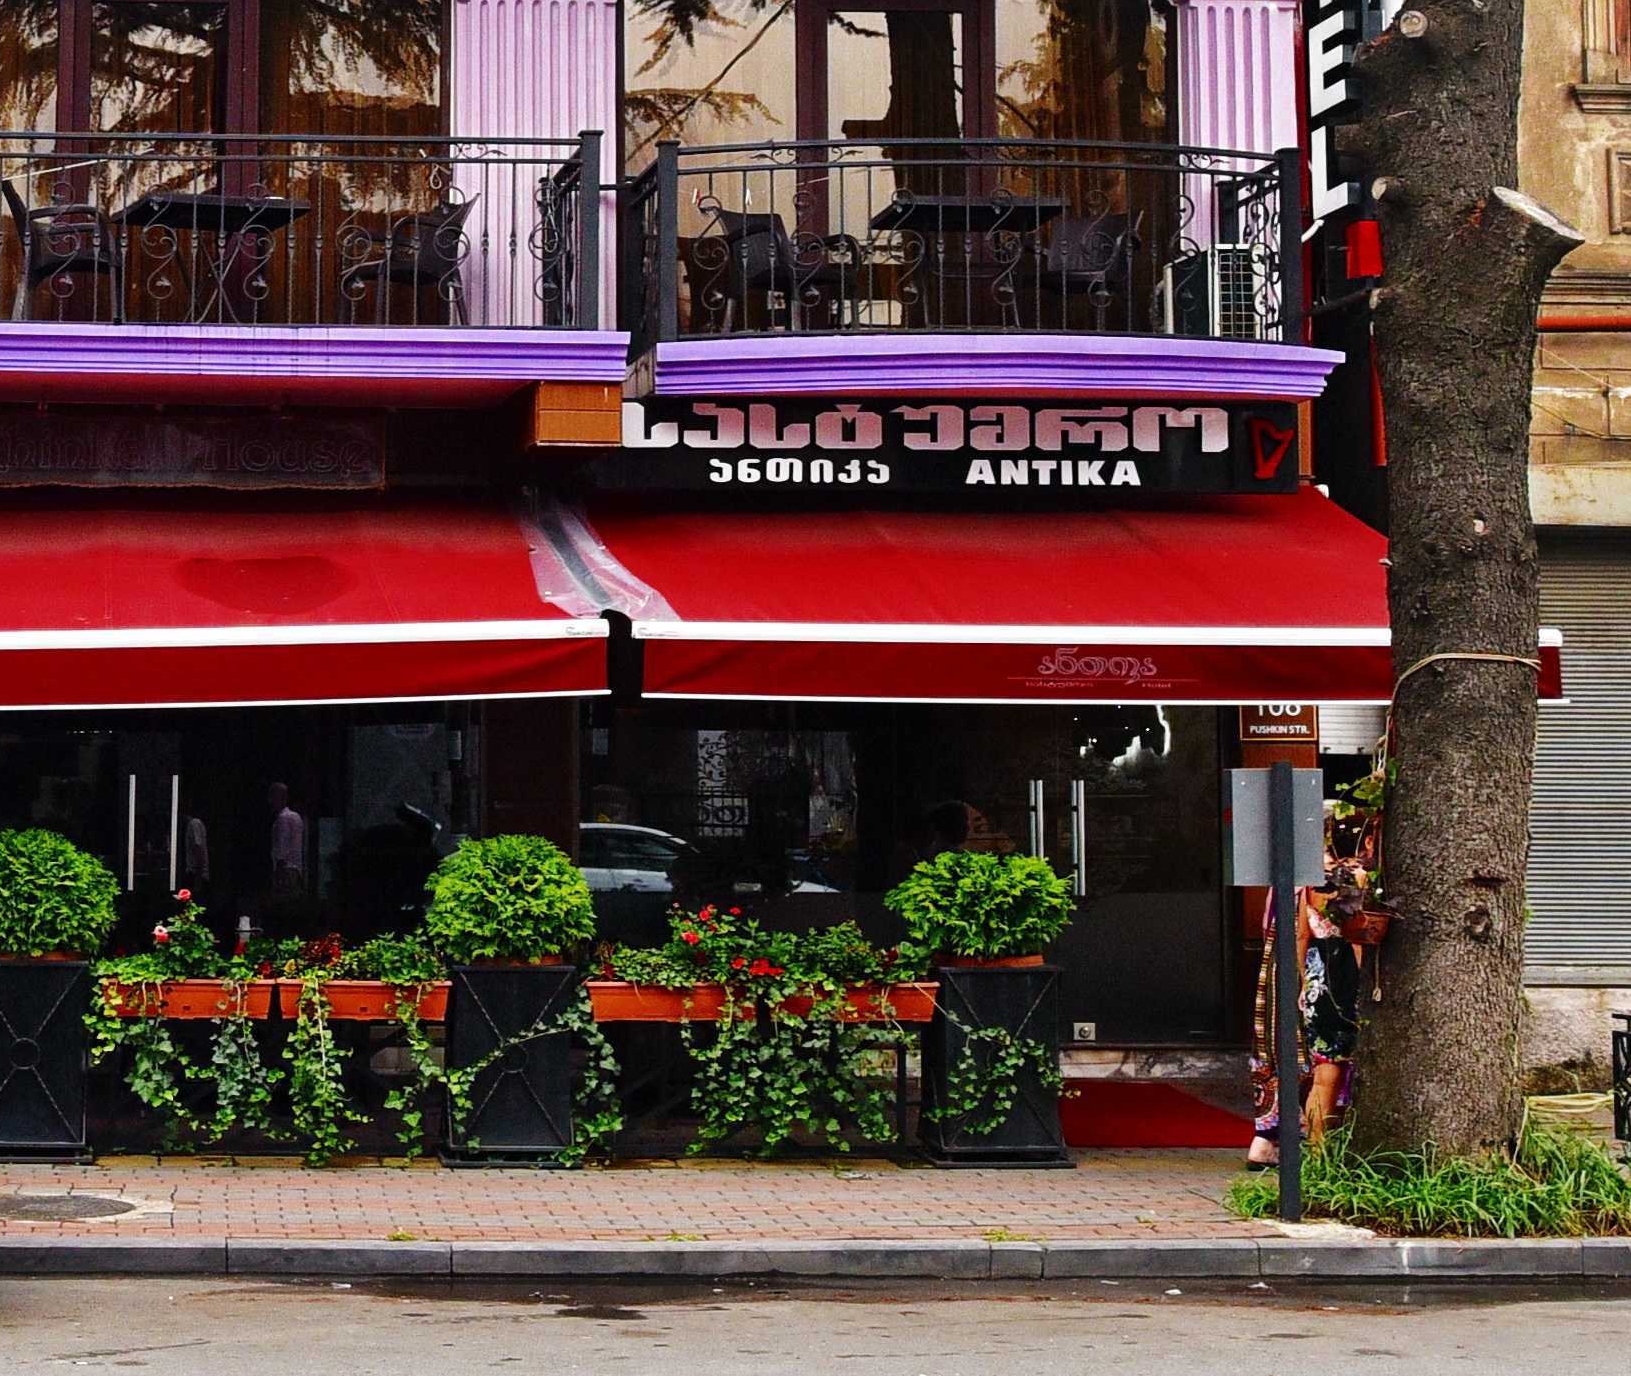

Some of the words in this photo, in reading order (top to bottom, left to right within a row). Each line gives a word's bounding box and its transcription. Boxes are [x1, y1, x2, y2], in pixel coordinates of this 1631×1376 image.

[622, 402, 1229, 453] სასტუმრო
[708, 457, 890, 484] ანთიკა
[965, 459, 1142, 486] ANTIKA
[1249, 725, 1288, 734] PUSHKIN
[1288, 725, 1311, 734] STR.
